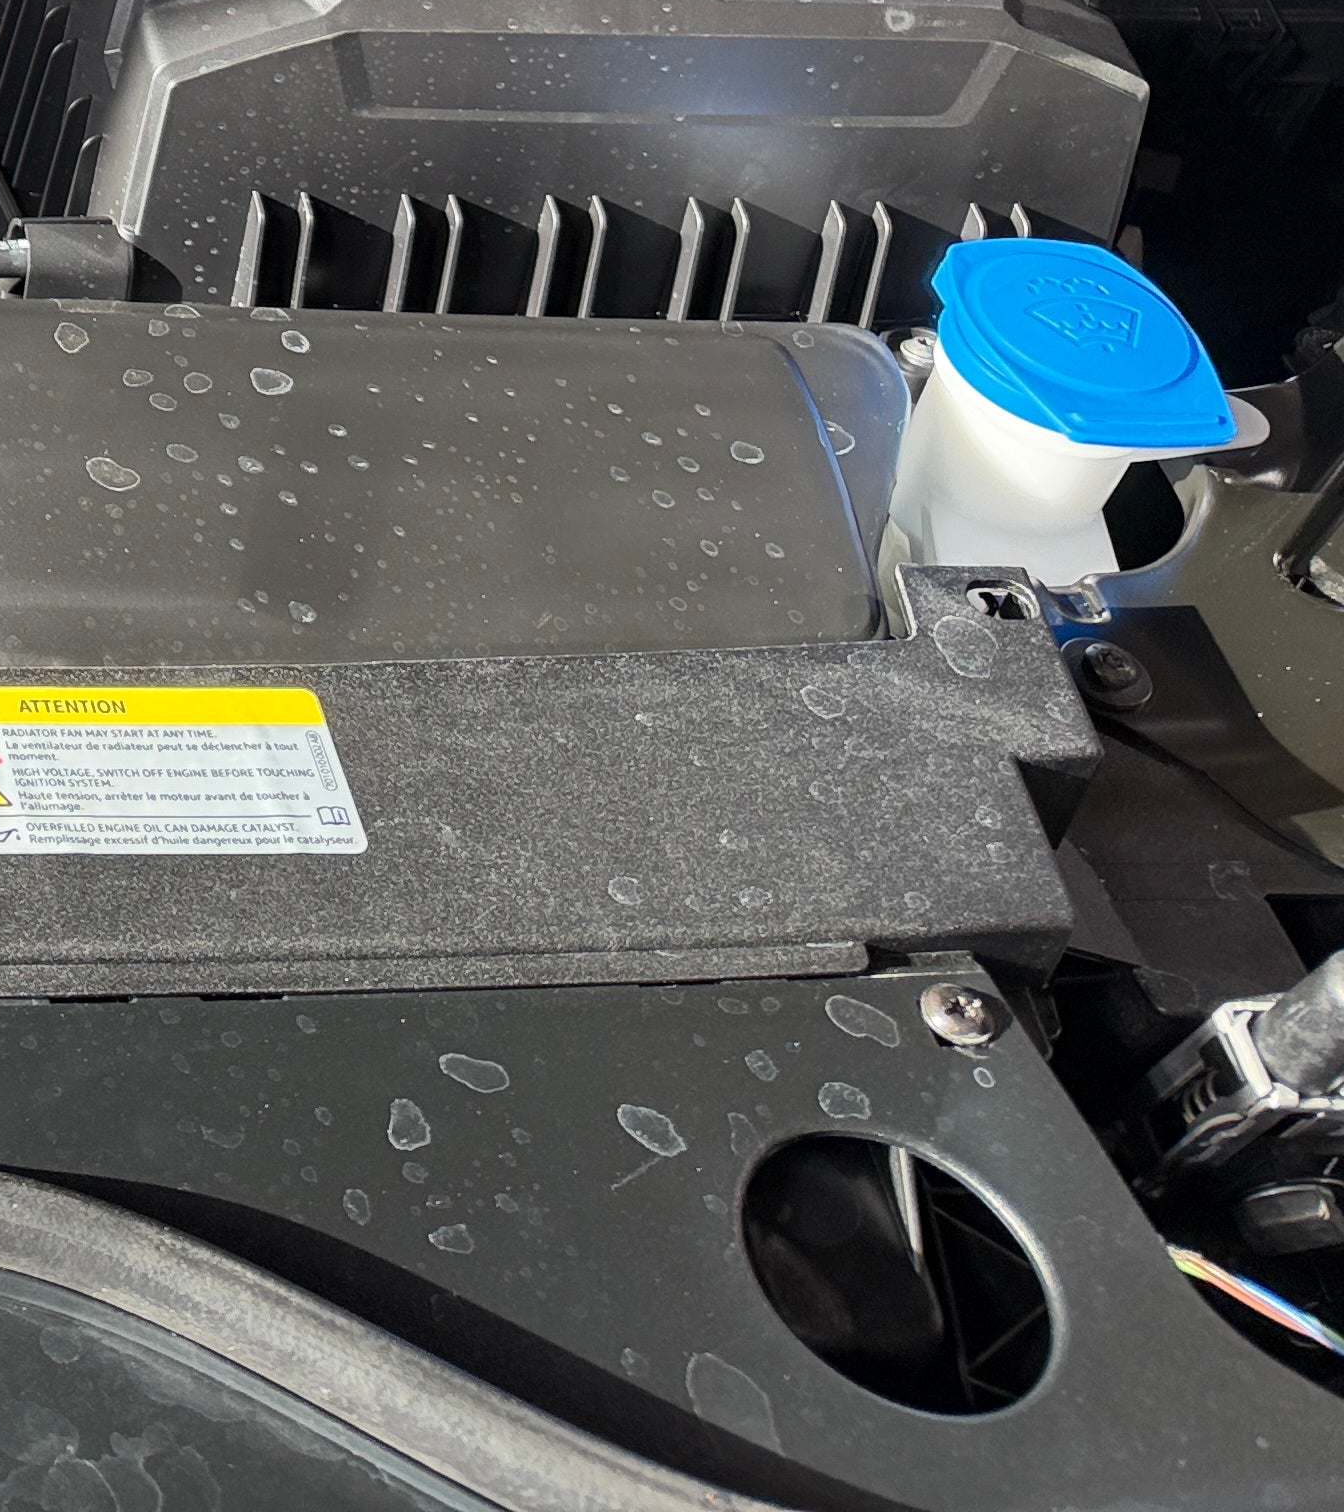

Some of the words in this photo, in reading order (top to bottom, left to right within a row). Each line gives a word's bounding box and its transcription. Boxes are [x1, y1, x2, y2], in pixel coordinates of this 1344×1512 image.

[19, 699, 126, 714] ATTENTION
[2, 728, 57, 738] RADIATOR
[61, 728, 82, 738] FAN
[85, 729, 108, 738] MAY
[111, 729, 143, 738] START
[147, 729, 160, 738] AT
[162, 729, 184, 738] ANY
[188, 729, 218, 739] TIME.
[5, 741, 19, 750] Le
[22, 741, 82, 751] ventilateur
[85, 741, 99, 750] de
[102, 741, 153, 751] radiateur
[157, 743, 184, 753] peut
[201, 741, 262, 751] déclencher
[265, 741, 272, 751] à
[274, 742, 299, 751] tout
[8, 753, 58, 761] moment.
[12, 768, 41, 777] HIGH
[97, 768, 140, 778] SWITCH
[142, 769, 163, 777] OFF
[167, 769, 208, 778] ENGINE
[211, 768, 255, 777] BEFORE
[256, 768, 315, 778] TOUCHING
[15, 778, 65, 787] IGNITION
[68, 779, 114, 787] SYSTEM.
[18, 791, 51, 801] Haute
[55, 791, 102, 802] tension,
[104, 791, 143, 801] arrêter
[147, 792, 156, 801] le
[159, 792, 201, 801] moteur
[204, 792, 236, 801] avant
[239, 792, 253, 801] de
[256, 792, 299, 801] toucher
[303, 791, 311, 801] à
[21, 802, 83, 813] l'allumage.
[26, 822, 95, 832] OVERFILLED
[98, 823, 140, 833] ENGINE
[143, 824, 162, 833] OIL
[164, 824, 188, 833] CAN
[192, 824, 238, 833] DAMAGE
[29, 834, 101, 845] Remplissage
[104, 835, 148, 845] excessif
[151, 835, 189, 845] d'huile
[192, 835, 252, 847] dangereux
[255, 836, 280, 846] pour
[283, 835, 293, 844] le
